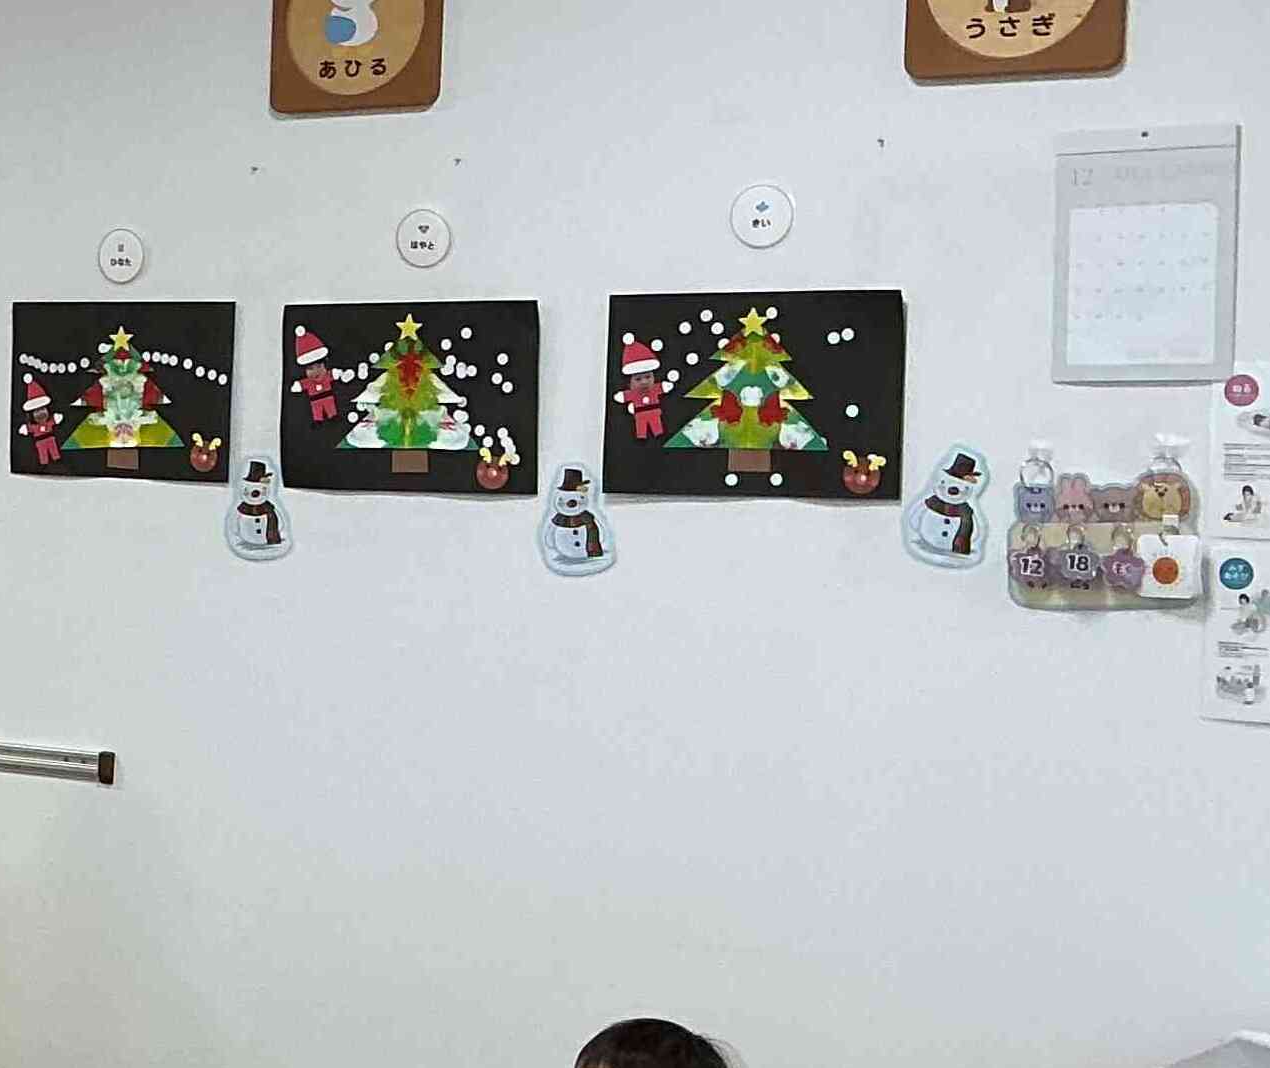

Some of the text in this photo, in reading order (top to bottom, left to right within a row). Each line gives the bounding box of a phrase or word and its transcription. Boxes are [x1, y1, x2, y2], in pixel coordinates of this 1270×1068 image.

[965, 13, 1056, 39] うさぎ
[318, 58, 387, 79] あひる
[410, 240, 435, 250] はやと
[1020, 557, 1043, 576] 12
[1068, 554, 1089, 572] 18
